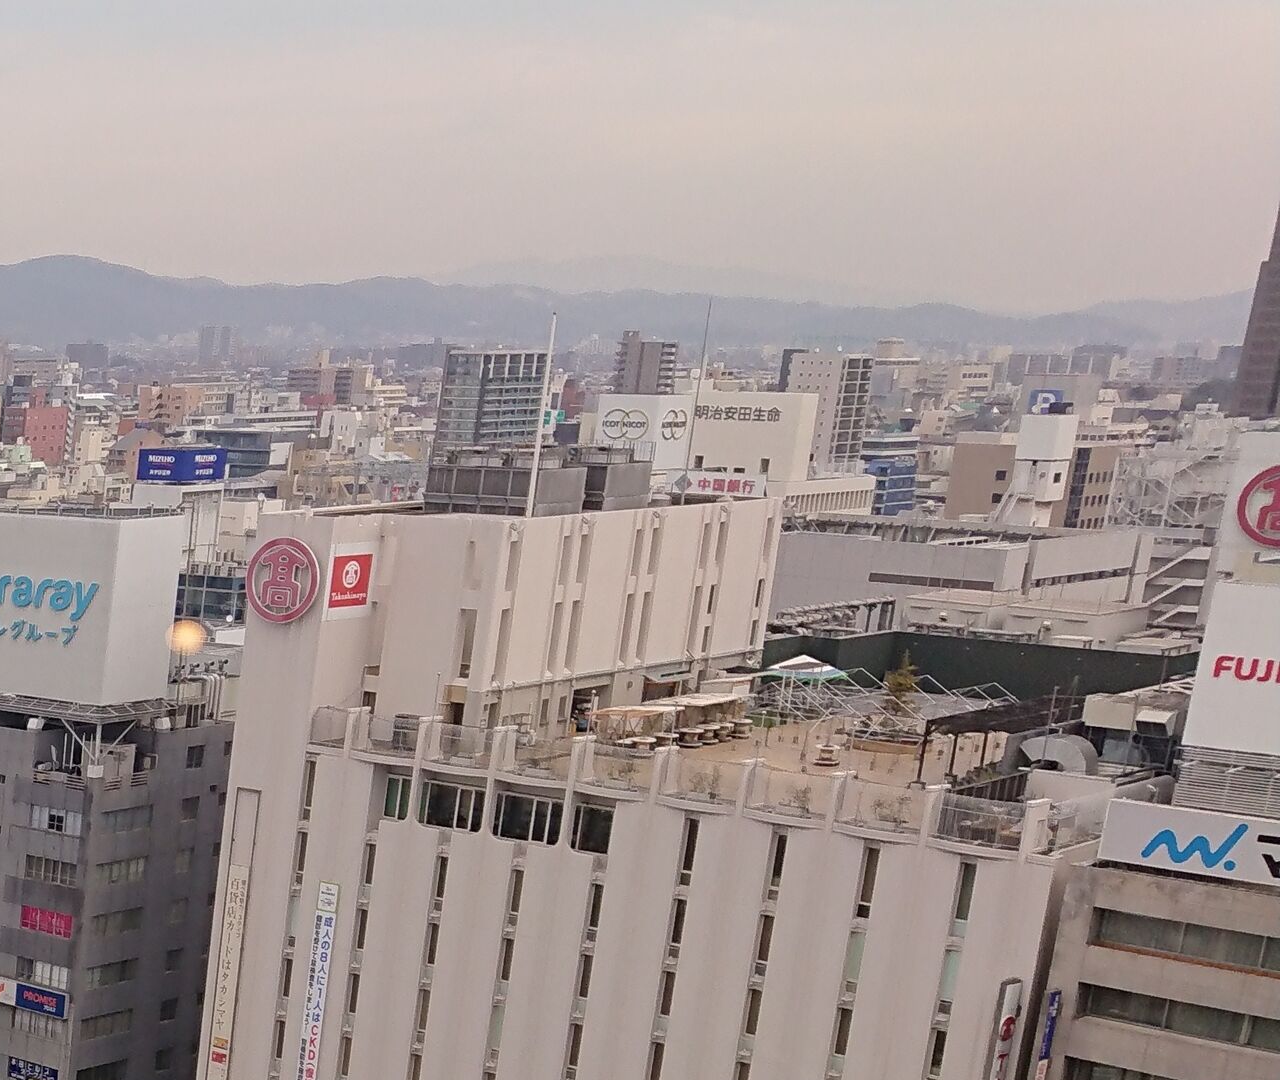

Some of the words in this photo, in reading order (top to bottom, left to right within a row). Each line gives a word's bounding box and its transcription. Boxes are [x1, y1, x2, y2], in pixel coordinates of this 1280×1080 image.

[694, 405, 782, 422] 明治安田生命
[148, 455, 175, 463] MIZUHO
[195, 454, 217, 462] MIZUHO
[698, 477, 756, 494] 中国銀行
[331, 591, 367, 601] Takashimaya
[23, 990, 57, 1008] PROMISE
